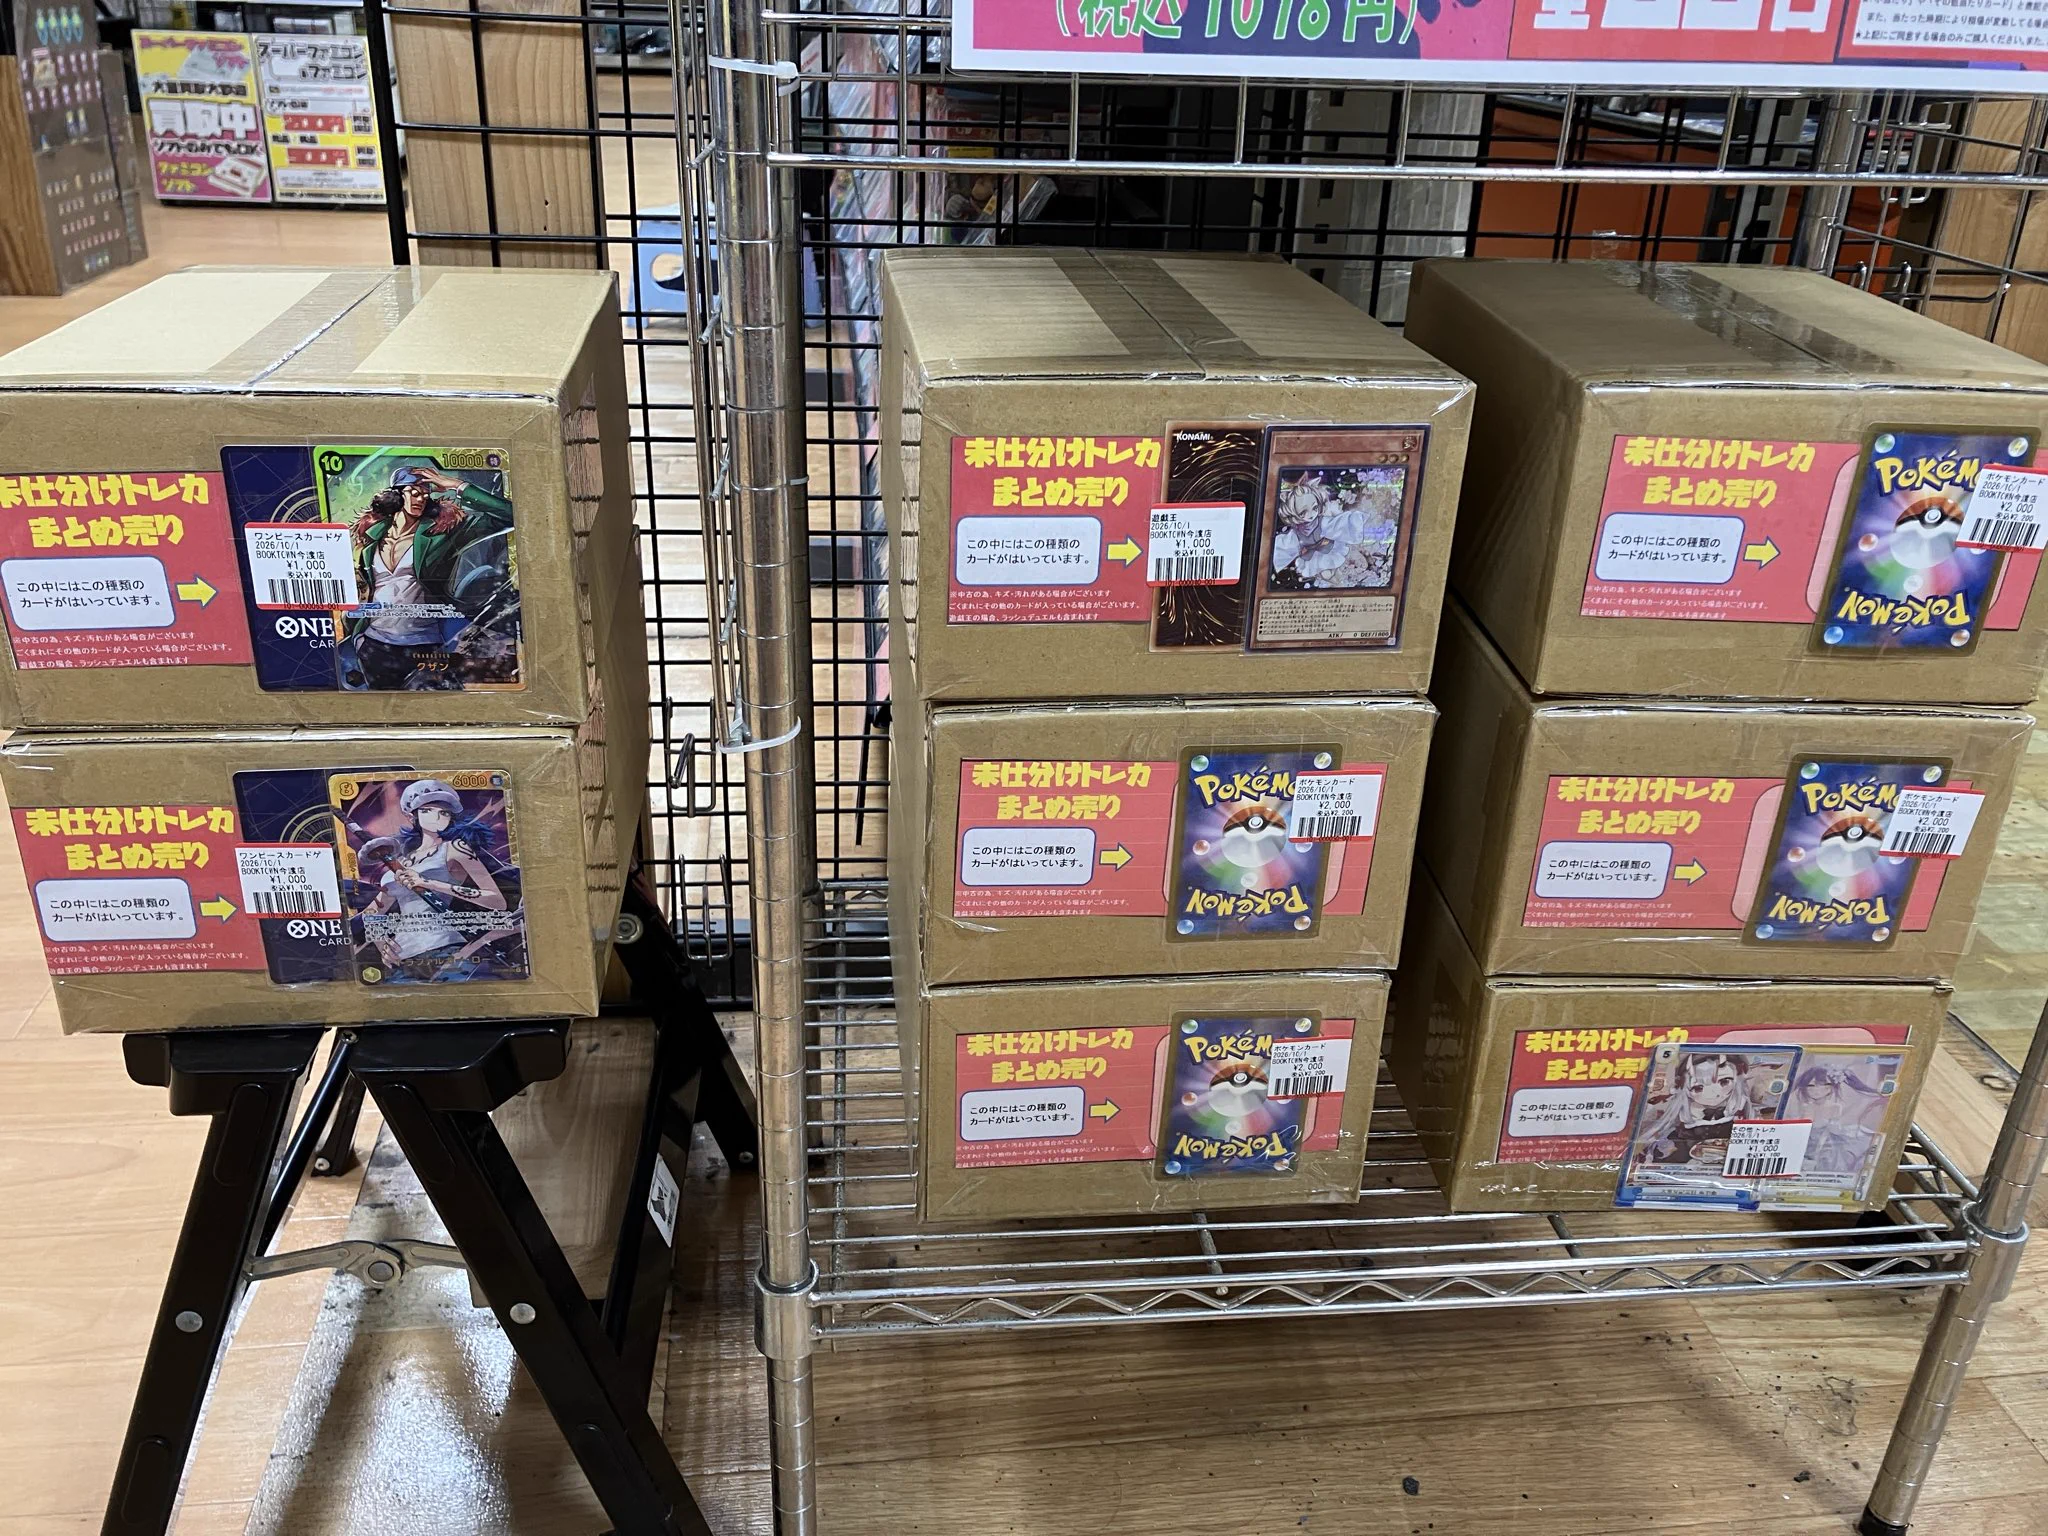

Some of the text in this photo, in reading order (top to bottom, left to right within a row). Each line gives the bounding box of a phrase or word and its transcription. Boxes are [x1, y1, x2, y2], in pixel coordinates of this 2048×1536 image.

[1176, 431, 1211, 441] KONAMI
[964, 436, 1162, 468] 未仕分けトレカ
[1624, 436, 1816, 472] 未仕分けトレカ
[321, 455, 343, 472] 10
[442, 454, 483, 467] 10000
[992, 476, 1129, 507] まとめ売り
[1643, 476, 1778, 508] まとめ売り
[1151, 513, 1177, 522] 遊戯王
[28, 514, 184, 548] まとめ売り
[1151, 521, 1190, 530] 2026/10/1
[254, 532, 343, 541] ワンピースカードゲ
[1611, 534, 1721, 548] この中にはこの種類の
[256, 541, 299, 550] 2026/10/1
[967, 538, 1080, 549] この中にはこの種類の
[966, 553, 1090, 565] カードがはいっています。
[1608, 549, 1727, 564] カードがはいっています。
[16, 579, 145, 592] この中にはこの種類の
[20, 594, 161, 608] カードがはいっています。
[309, 639, 335, 649] CAR
[417, 662, 449, 672] クザン
[971, 761, 1151, 788] 未仕分けトレカ
[452, 775, 487, 788] 6000
[1557, 776, 1735, 803] 未仕分けトレカ
[996, 795, 1121, 820] まとめ売り
[26, 806, 234, 837] 未仕分けトレカ
[1577, 809, 1701, 835] まとめ売り
[64, 841, 209, 870] まとめ売り
[239, 851, 321, 859] ワンピースカードゲ
[972, 846, 1076, 855] この中にはこの種類の
[971, 858, 1084, 868] カードがはいっています。
[1549, 860, 1651, 869] この中にはこの種類の
[1546, 871, 1657, 882] カードがはいっています。
[50, 898, 170, 909] この中にはこの種類の
[52, 911, 184, 923] カードがはいっています。
[967, 1028, 1133, 1056] 未仕分けトレカ
[1662, 1050, 1671, 1058] 5
[991, 1057, 1107, 1083] まとめ売り
[970, 1102, 1066, 1115] この中にはこの種類の
[1520, 1101, 1614, 1111] この中にはこの種類の
[970, 1113, 1075, 1125] カードがはいっています。
[1518, 1112, 1620, 1122] カードがはいっています。
